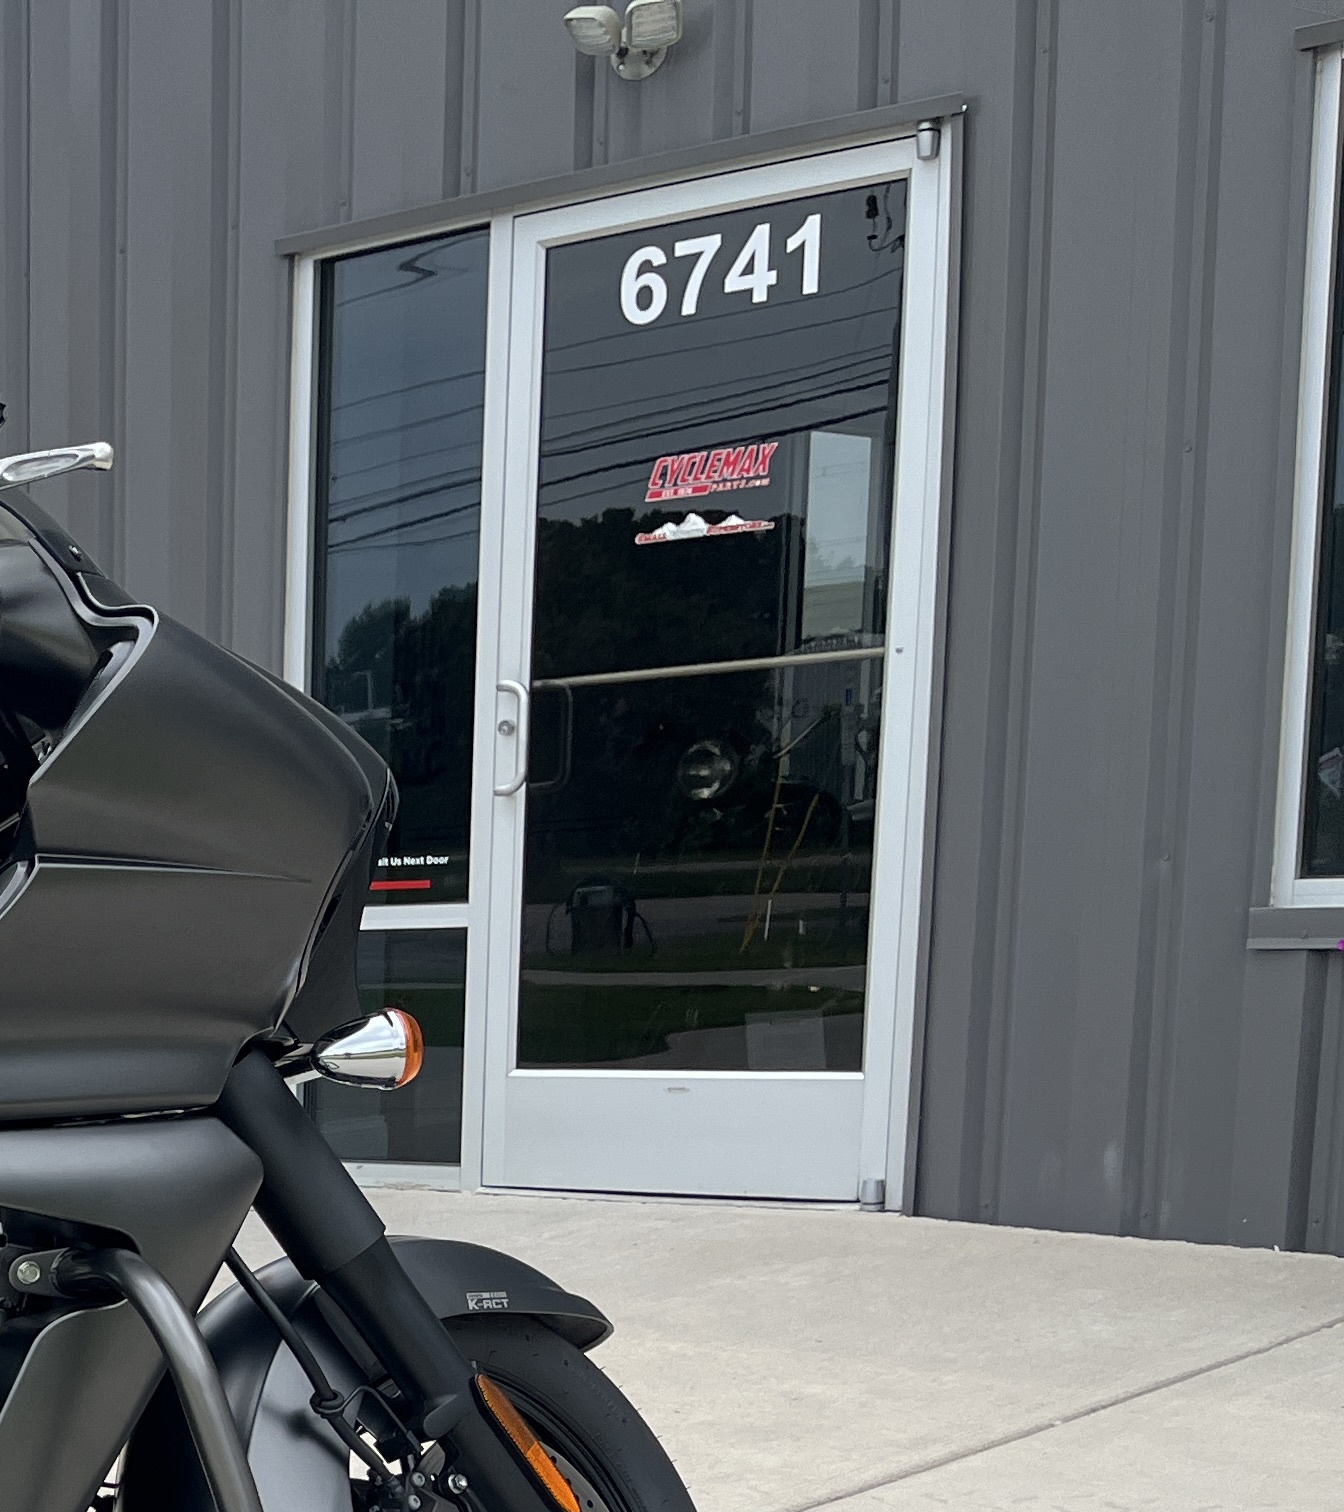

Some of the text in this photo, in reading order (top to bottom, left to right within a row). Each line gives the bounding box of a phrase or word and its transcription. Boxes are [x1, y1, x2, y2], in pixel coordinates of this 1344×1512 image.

[620, 213, 822, 326] 6741
[647, 441, 779, 489] CYCLEMAX
[390, 856, 402, 867] Us
[403, 855, 425, 866] Next
[426, 855, 450, 865] Door
[468, 1298, 510, 1311] K-ACT
